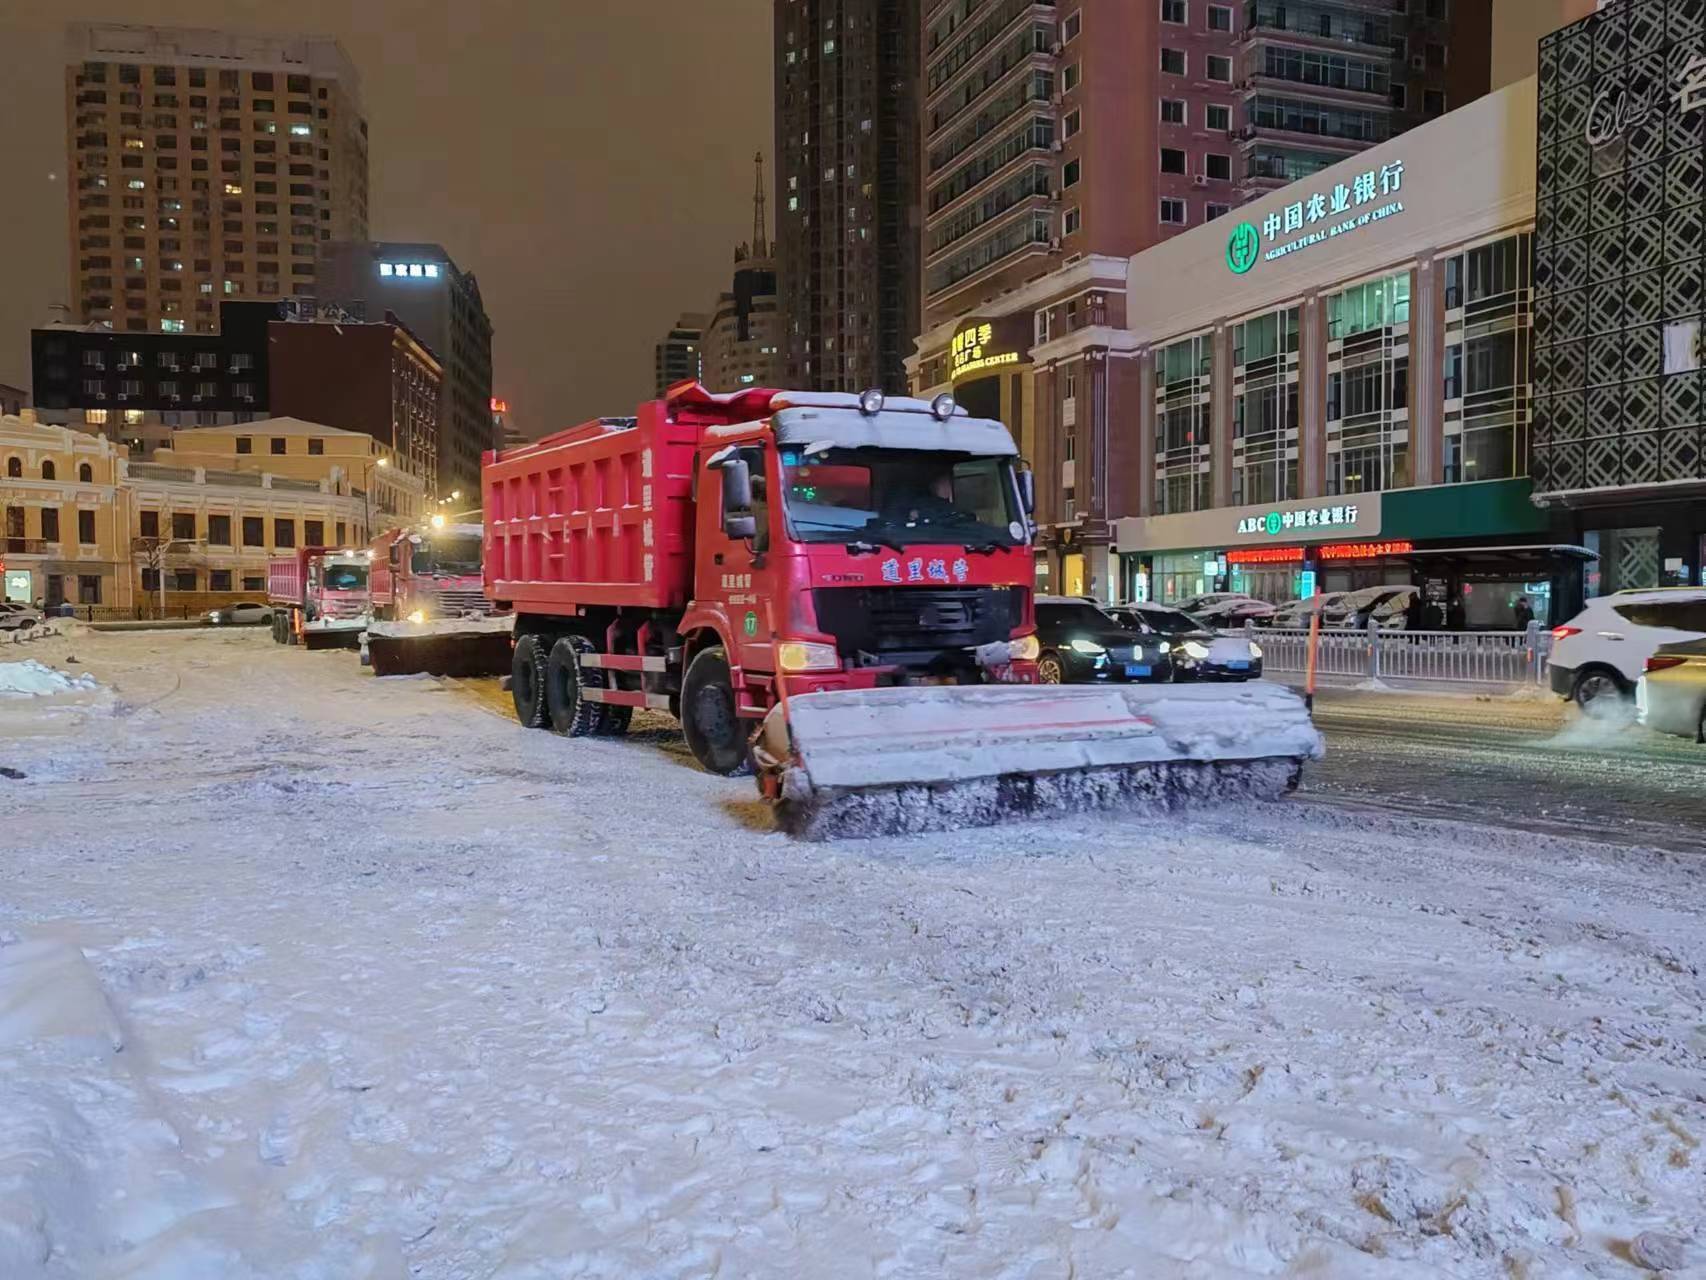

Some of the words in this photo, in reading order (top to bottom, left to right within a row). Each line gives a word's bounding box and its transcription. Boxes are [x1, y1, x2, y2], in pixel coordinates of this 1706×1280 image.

[1263, 160, 1404, 241] 中国农业银行
[1264, 230, 1328, 262] AGRICULTURAL
[1330, 219, 1357, 237] BANK
[1358, 211, 1372, 226] OF
[1372, 202, 1405, 221] CHINA
[985, 352, 1018, 366] CENTER
[1237, 517, 1266, 533] ABC
[1283, 506, 1358, 528] 中国农业银行
[881, 558, 969, 584] 道里城管
